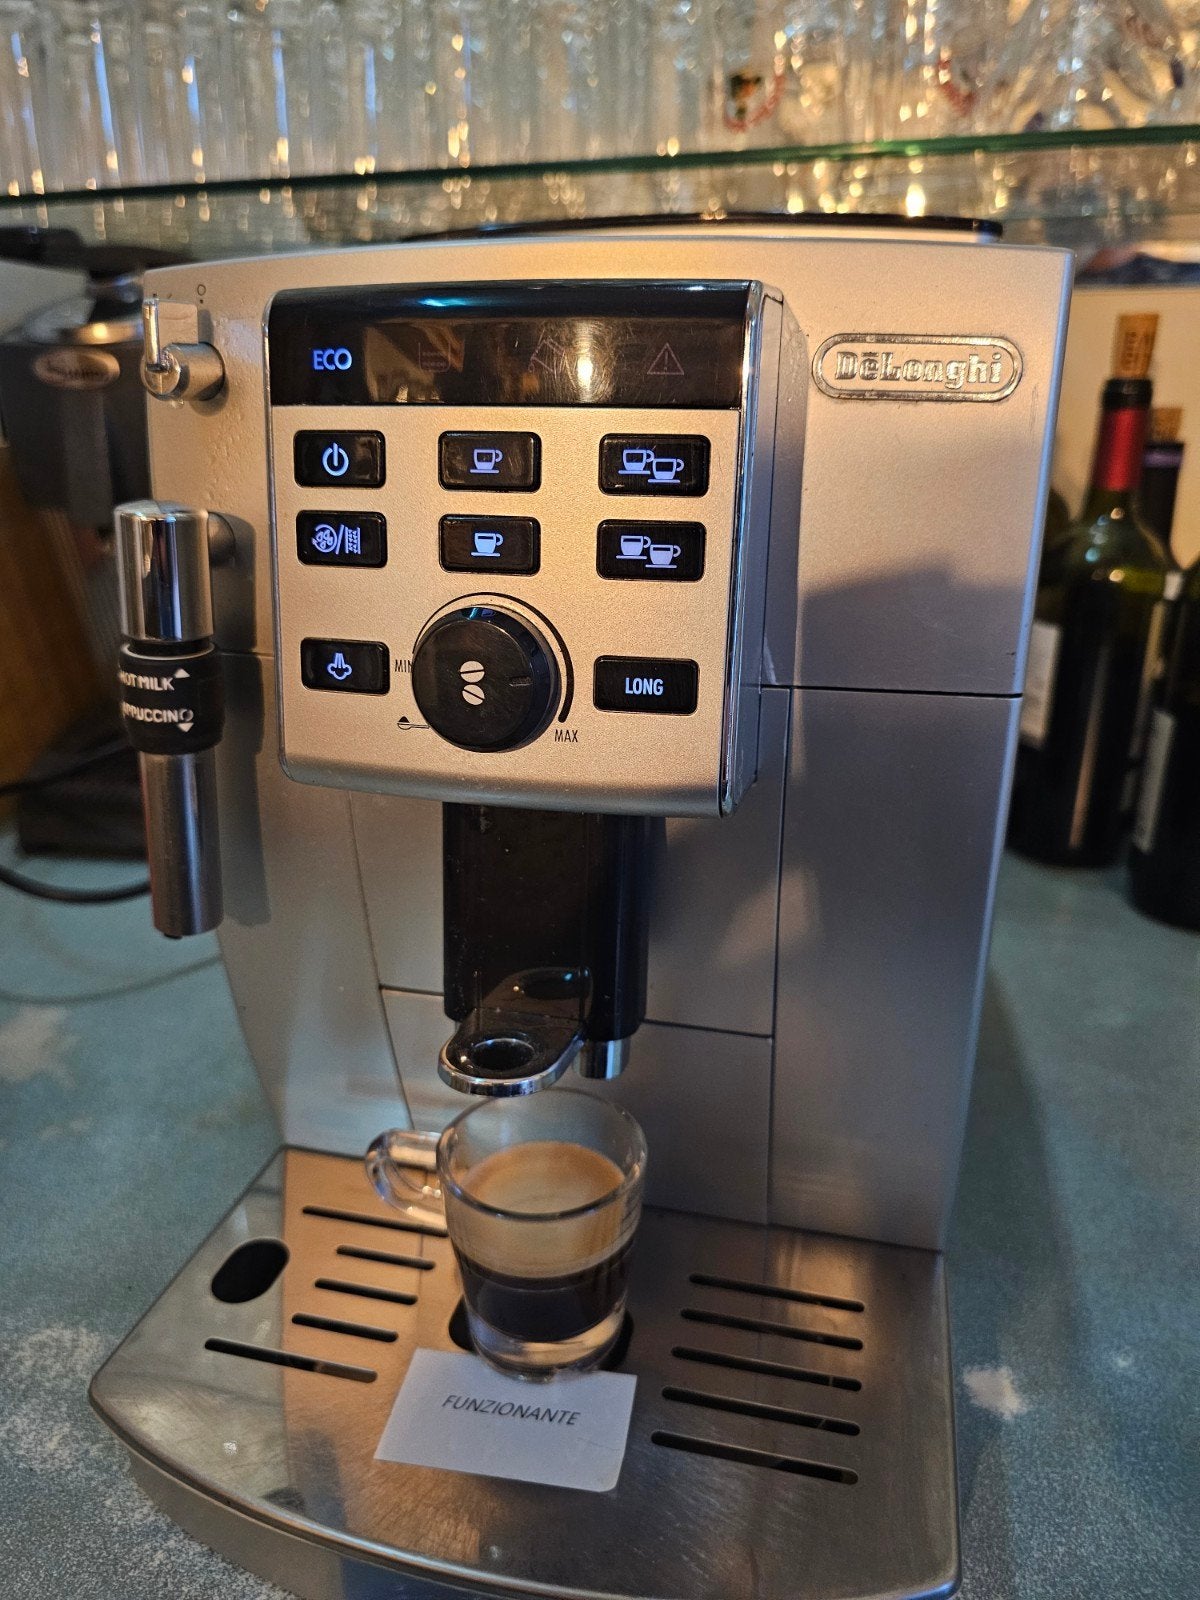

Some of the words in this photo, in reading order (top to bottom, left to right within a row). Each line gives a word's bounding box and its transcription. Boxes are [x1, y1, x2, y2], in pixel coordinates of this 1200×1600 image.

[313, 347, 353, 371] ECO
[137, 675, 175, 691] MILK
[625, 677, 664, 696] LONG
[554, 729, 578, 743] MAX
[441, 1394, 581, 1426] FUNZIONANTE
